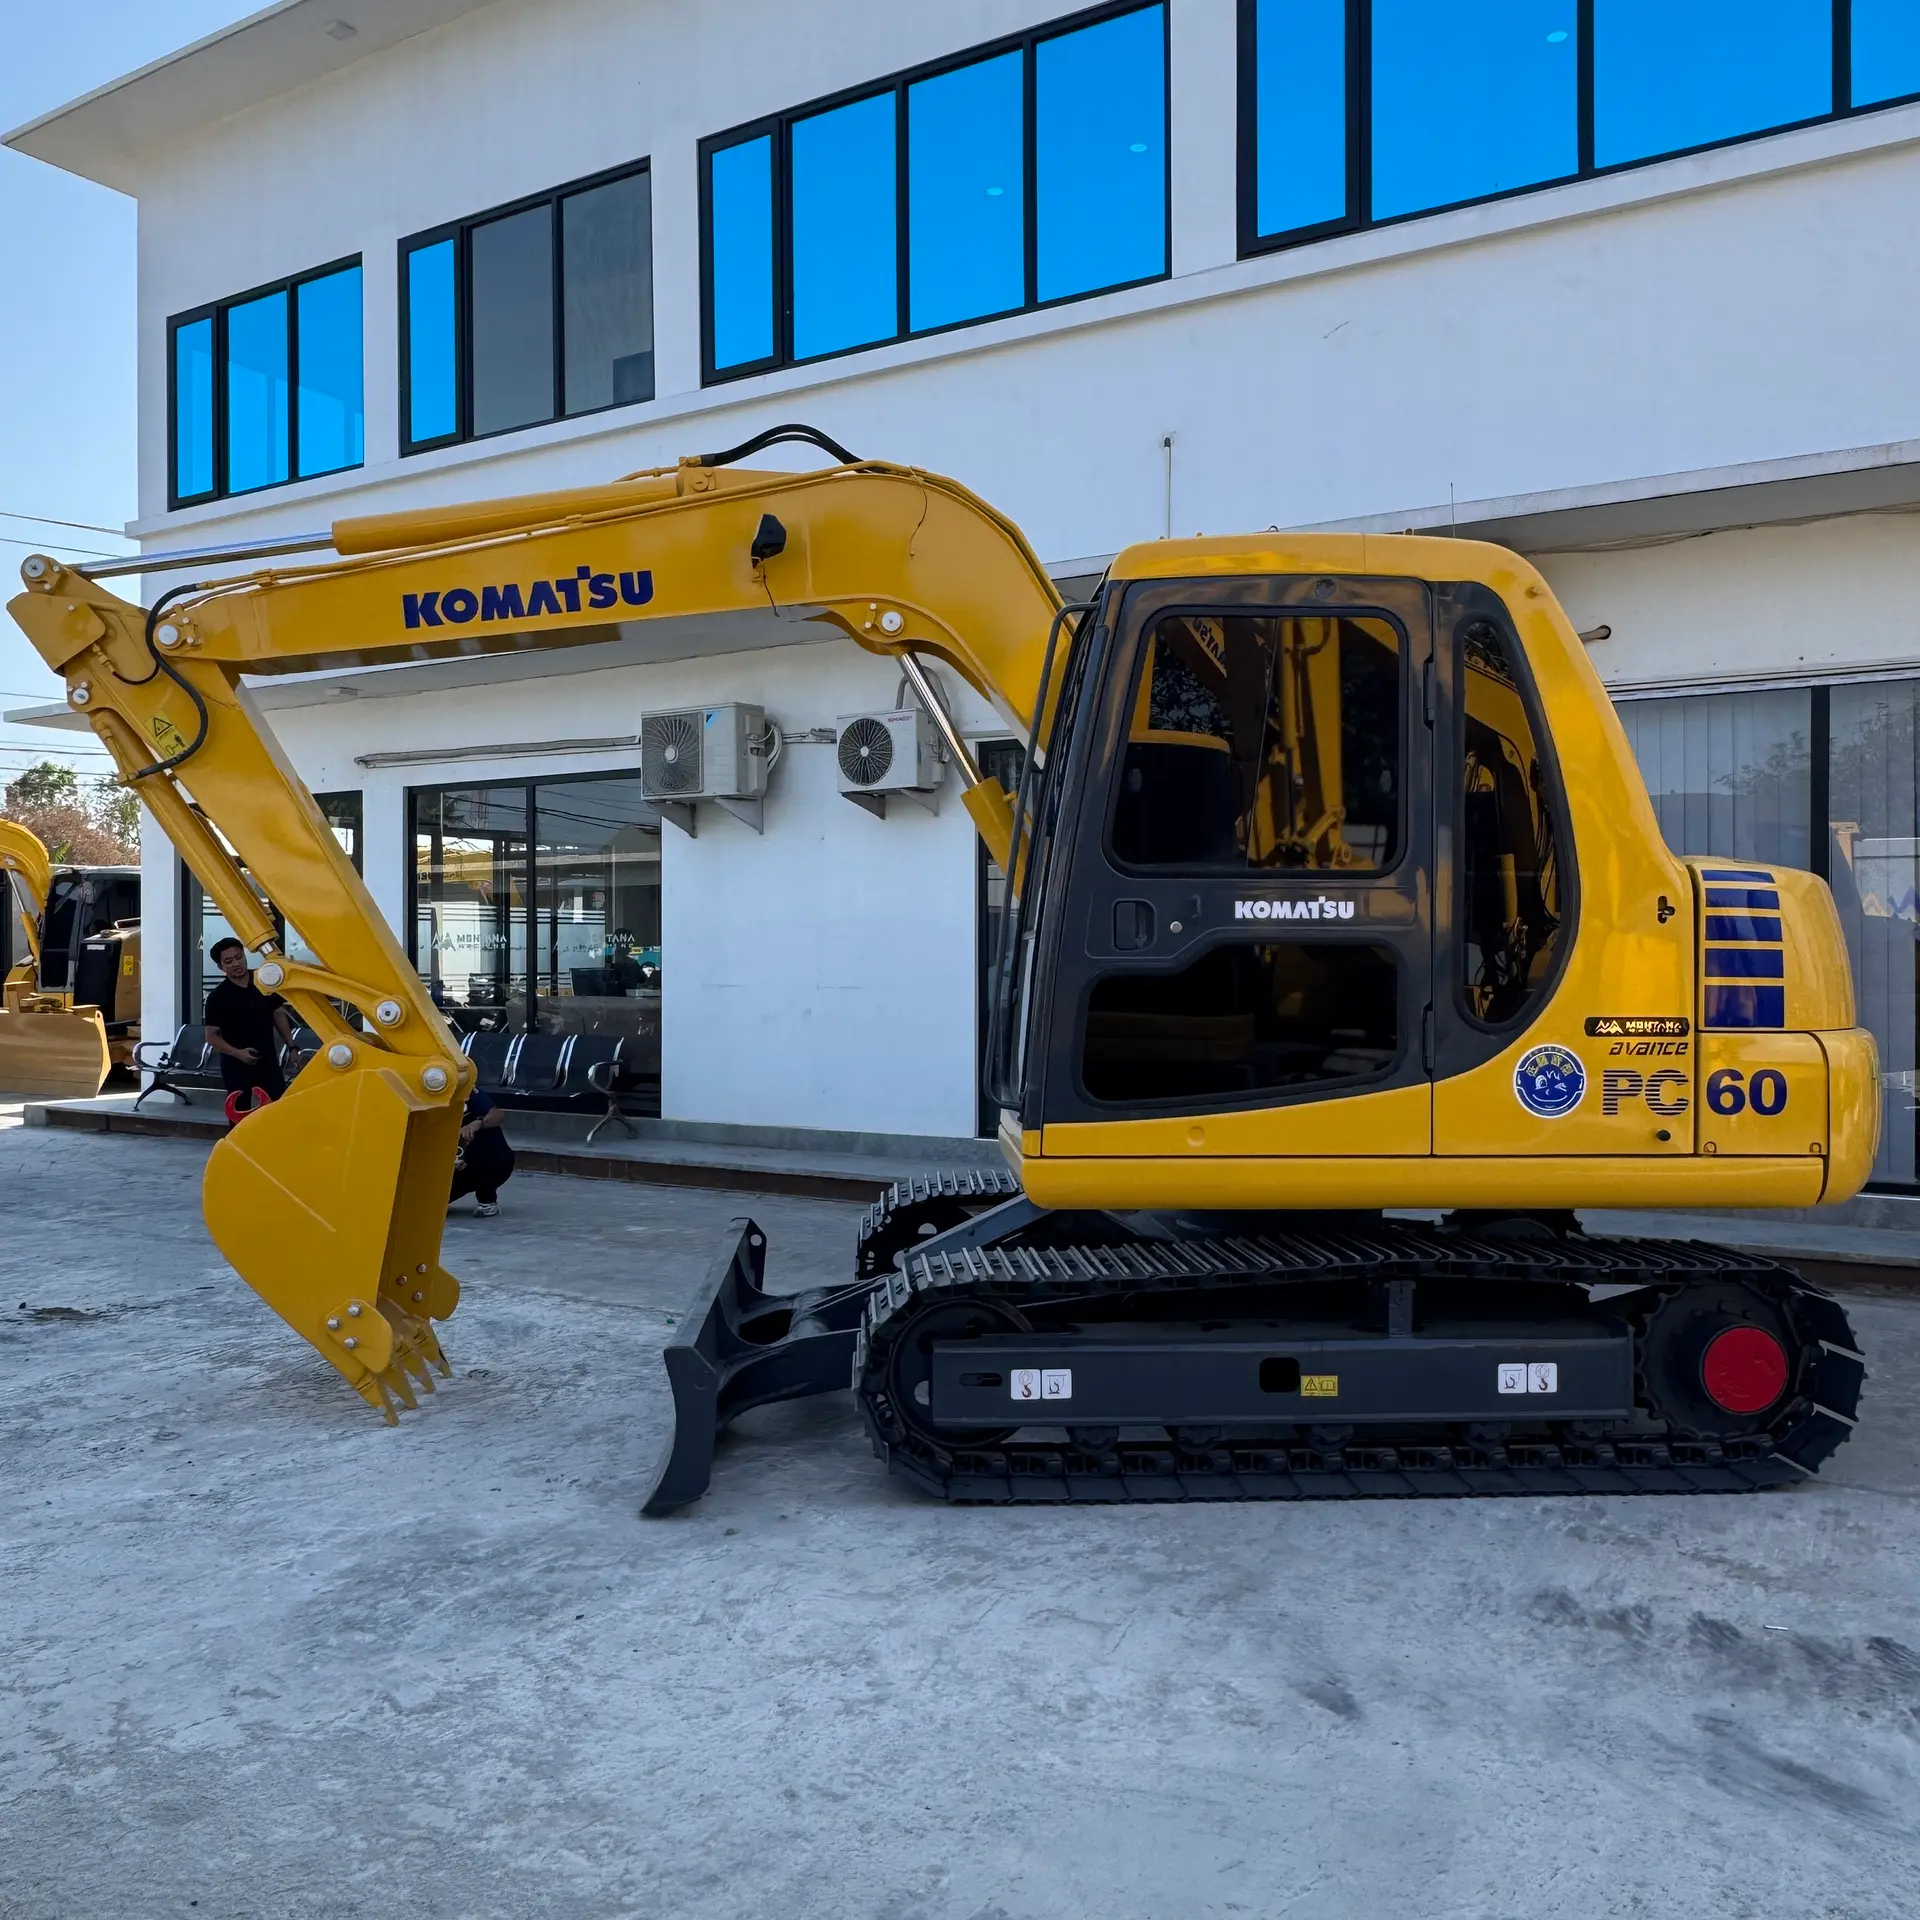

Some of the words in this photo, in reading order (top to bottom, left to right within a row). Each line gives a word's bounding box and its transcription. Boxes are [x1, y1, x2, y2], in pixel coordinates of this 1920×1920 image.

[402, 565, 654, 629] KOMATSU
[1235, 896, 1354, 919] KOMATSU
[1608, 1041, 1689, 1056] avance
[1602, 1069, 1690, 1116] PC
[1706, 1068, 1788, 1116] 60
